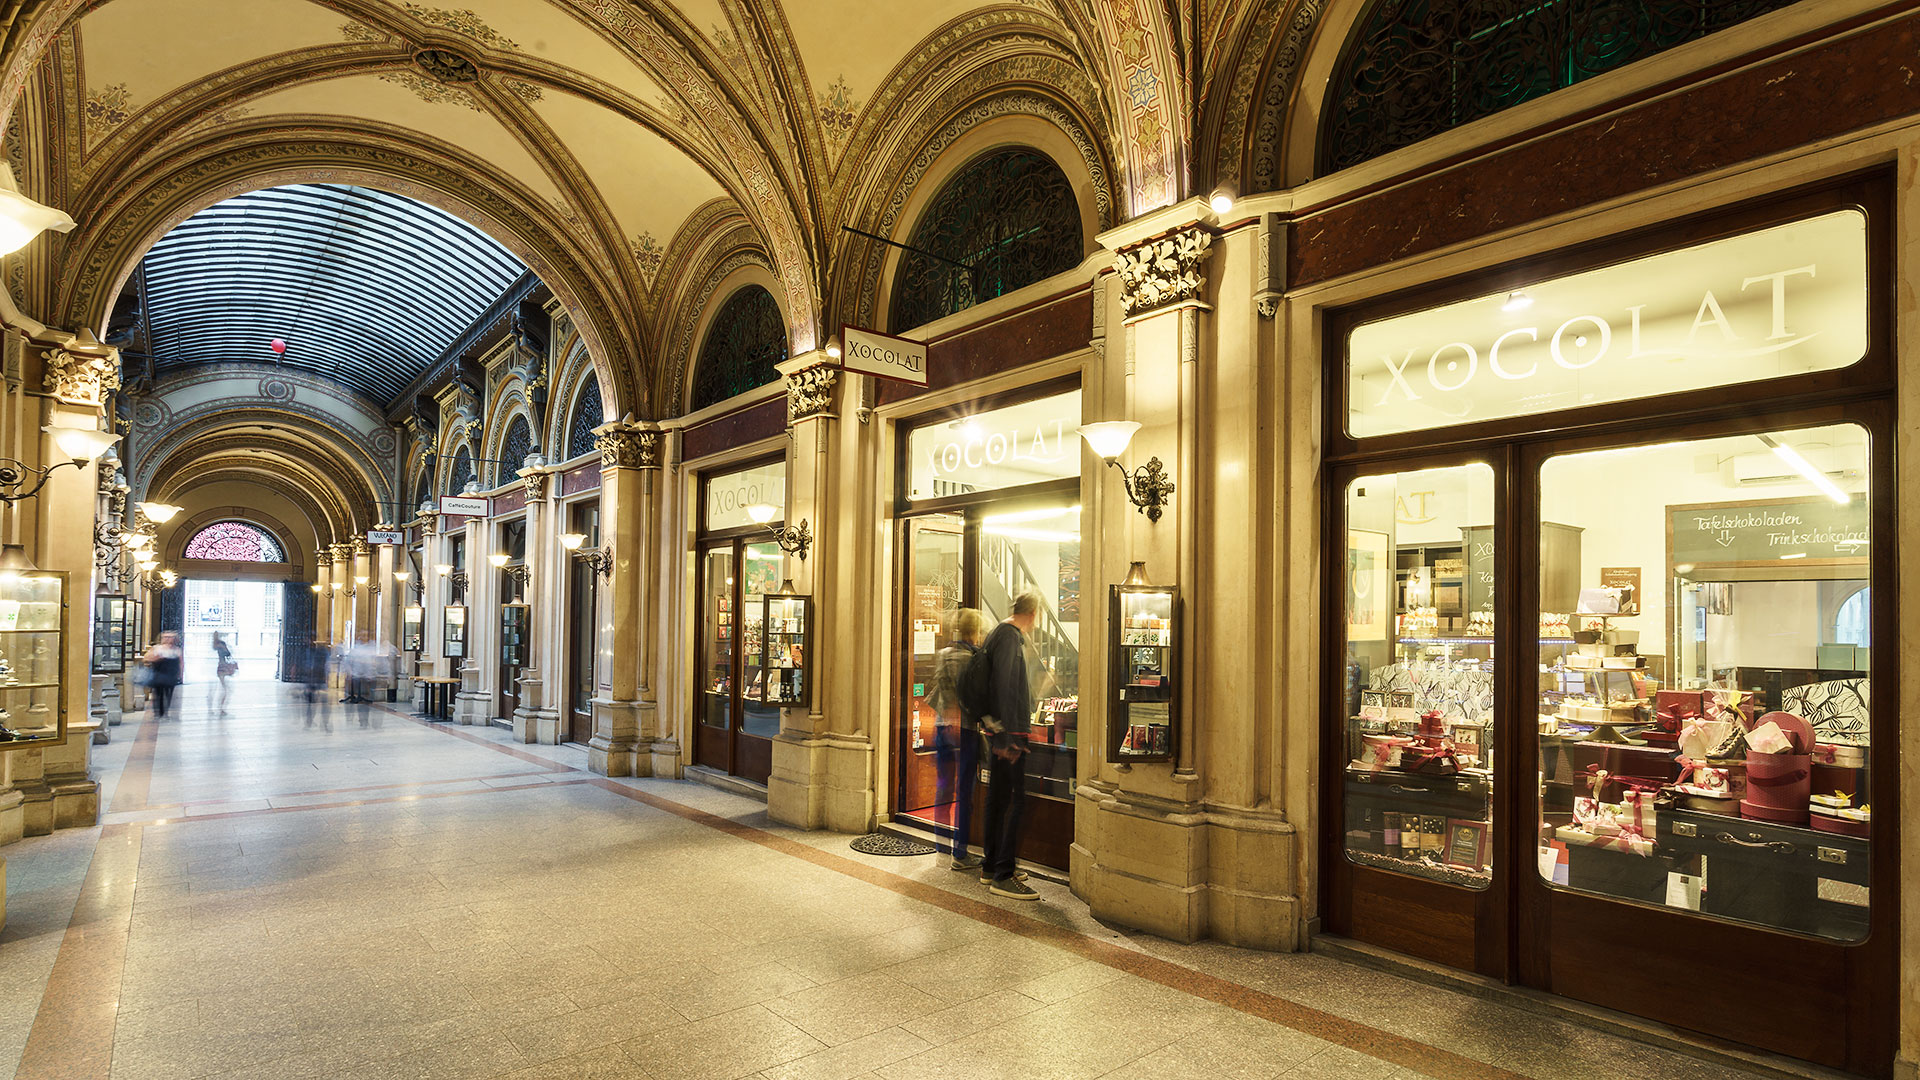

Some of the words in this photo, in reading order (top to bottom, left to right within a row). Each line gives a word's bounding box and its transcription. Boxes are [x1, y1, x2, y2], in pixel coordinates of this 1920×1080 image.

[1375, 264, 1822, 407] XOCOLAT
[848, 340, 923, 372] XOCOLAT
[926, 417, 1072, 477] XOCOLAT
[1693, 511, 1802, 534] Tafelschokoladen
[1766, 524, 1869, 547] Trinkschokolad
